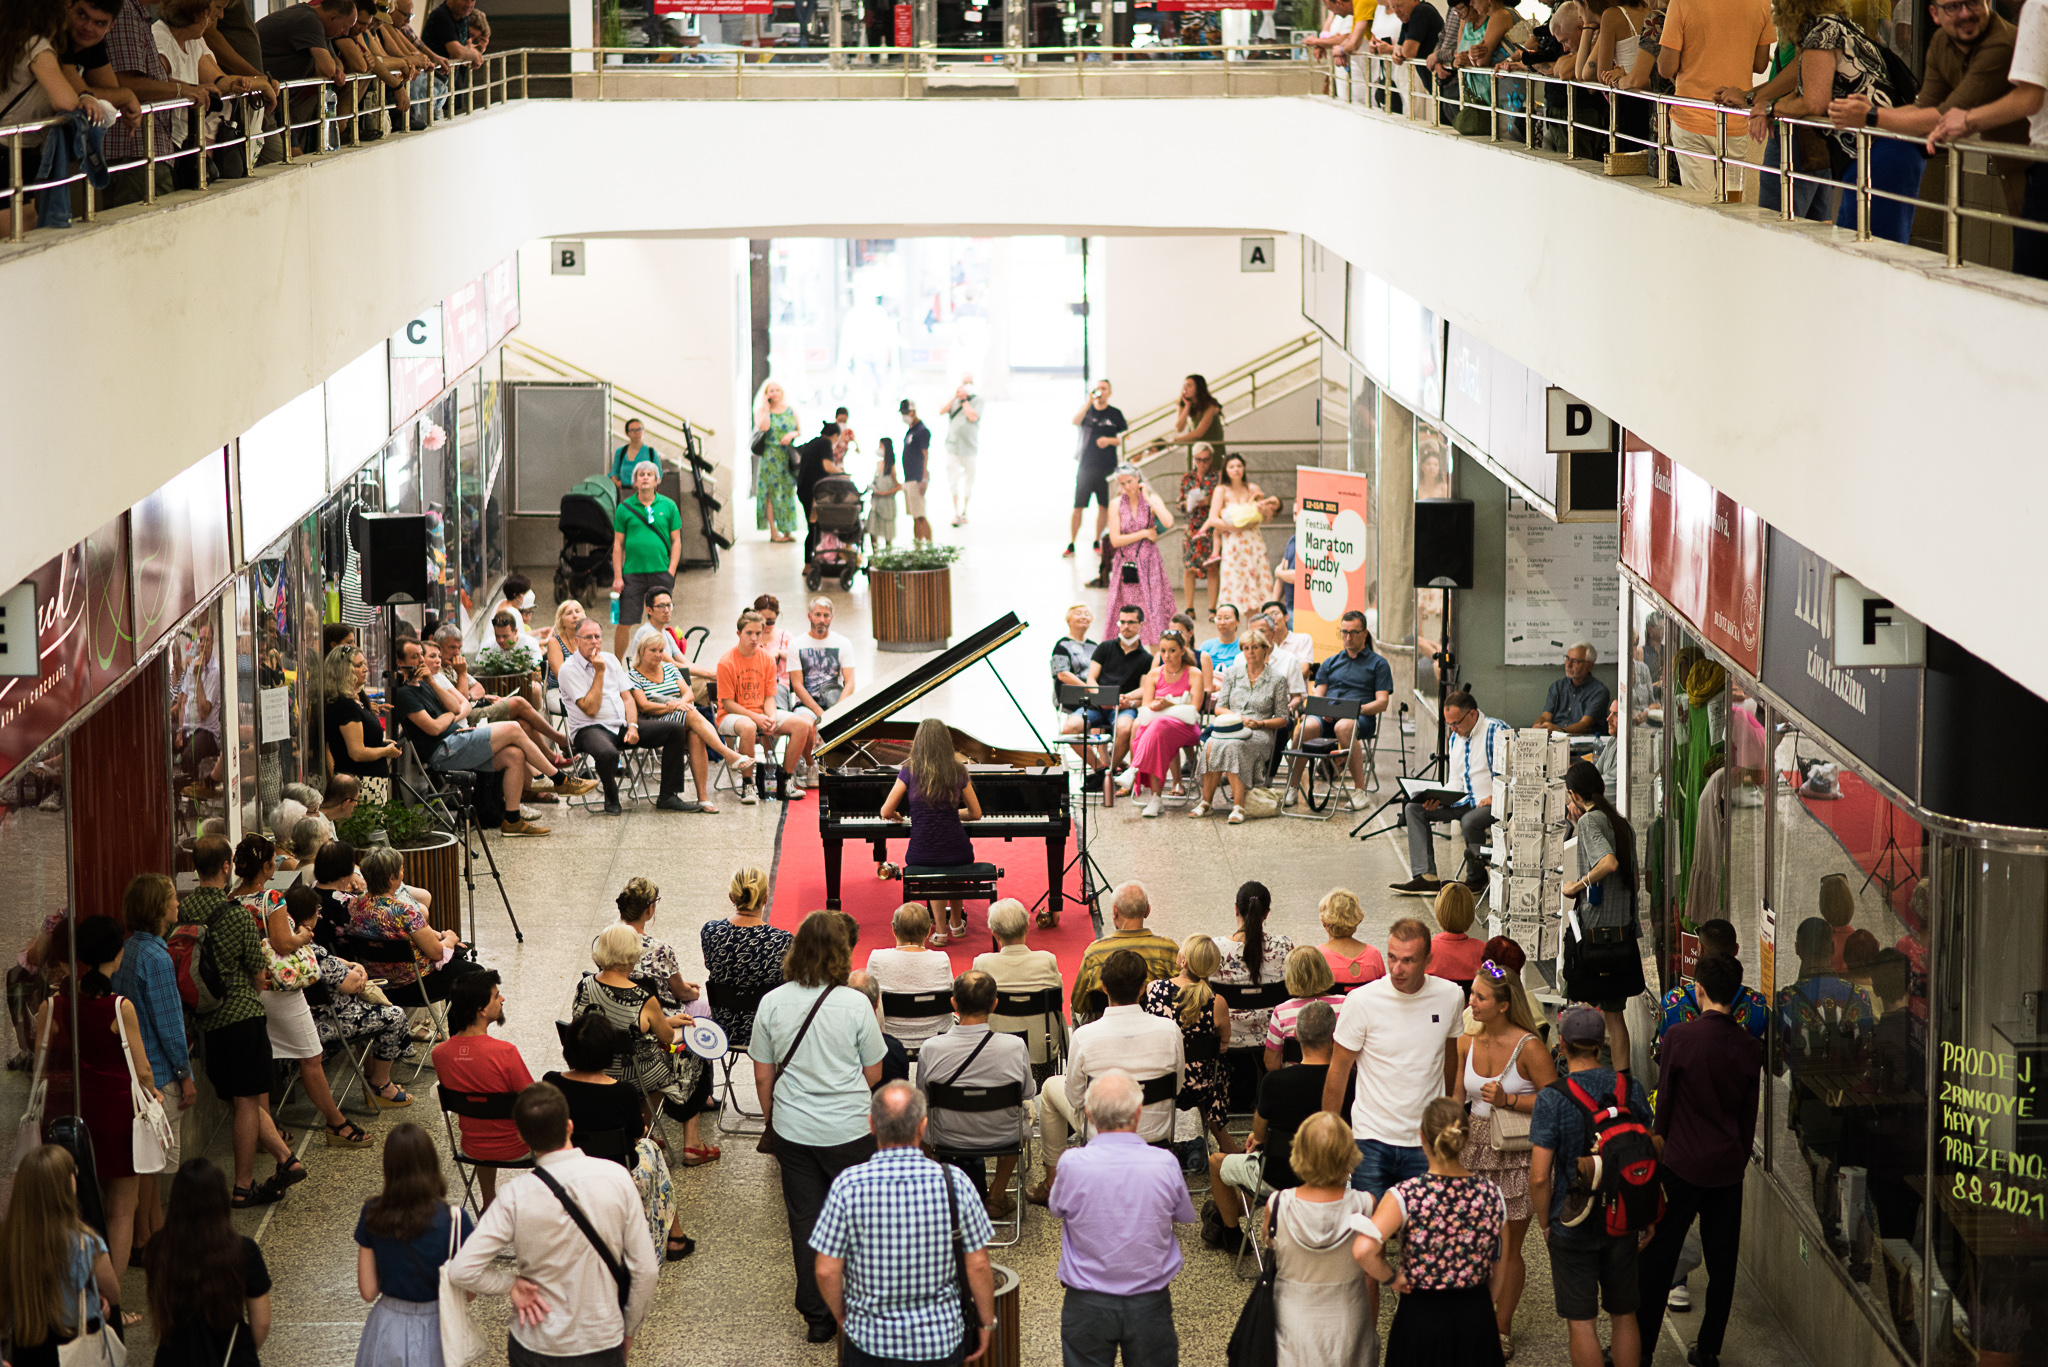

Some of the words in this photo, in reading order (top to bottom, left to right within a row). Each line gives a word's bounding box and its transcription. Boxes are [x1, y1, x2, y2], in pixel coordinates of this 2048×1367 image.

[561, 250, 576, 268] B
[1249, 246, 1265, 265] A
[406, 319, 427, 345] C
[1566, 404, 1593, 437] D
[1305, 518, 1333, 531] Festival
[1305, 532, 1353, 555] Maraton
[1305, 553, 1340, 578] hudby
[1304, 573, 1332, 594] Brno
[1714, 610, 1727, 632] BUĎTE
[1727, 620, 1740, 643] KOČKA
[1863, 599, 1894, 645] F
[18, 698, 26, 714] BY
[30, 664, 66, 705] CHOCOLATE
[741, 682, 760, 691] NEW
[1806, 643, 1824, 684] KÁVA
[1825, 660, 1831, 689] &
[1831, 668, 1866, 715] PRAŽÍRNA
[739, 692, 761, 700] YORK
[1940, 1041, 2031, 1083] PRODEJ
[1939, 1081, 2036, 1117] ZRNKOVÉ
[1944, 1104, 1991, 1137] KÁVY
